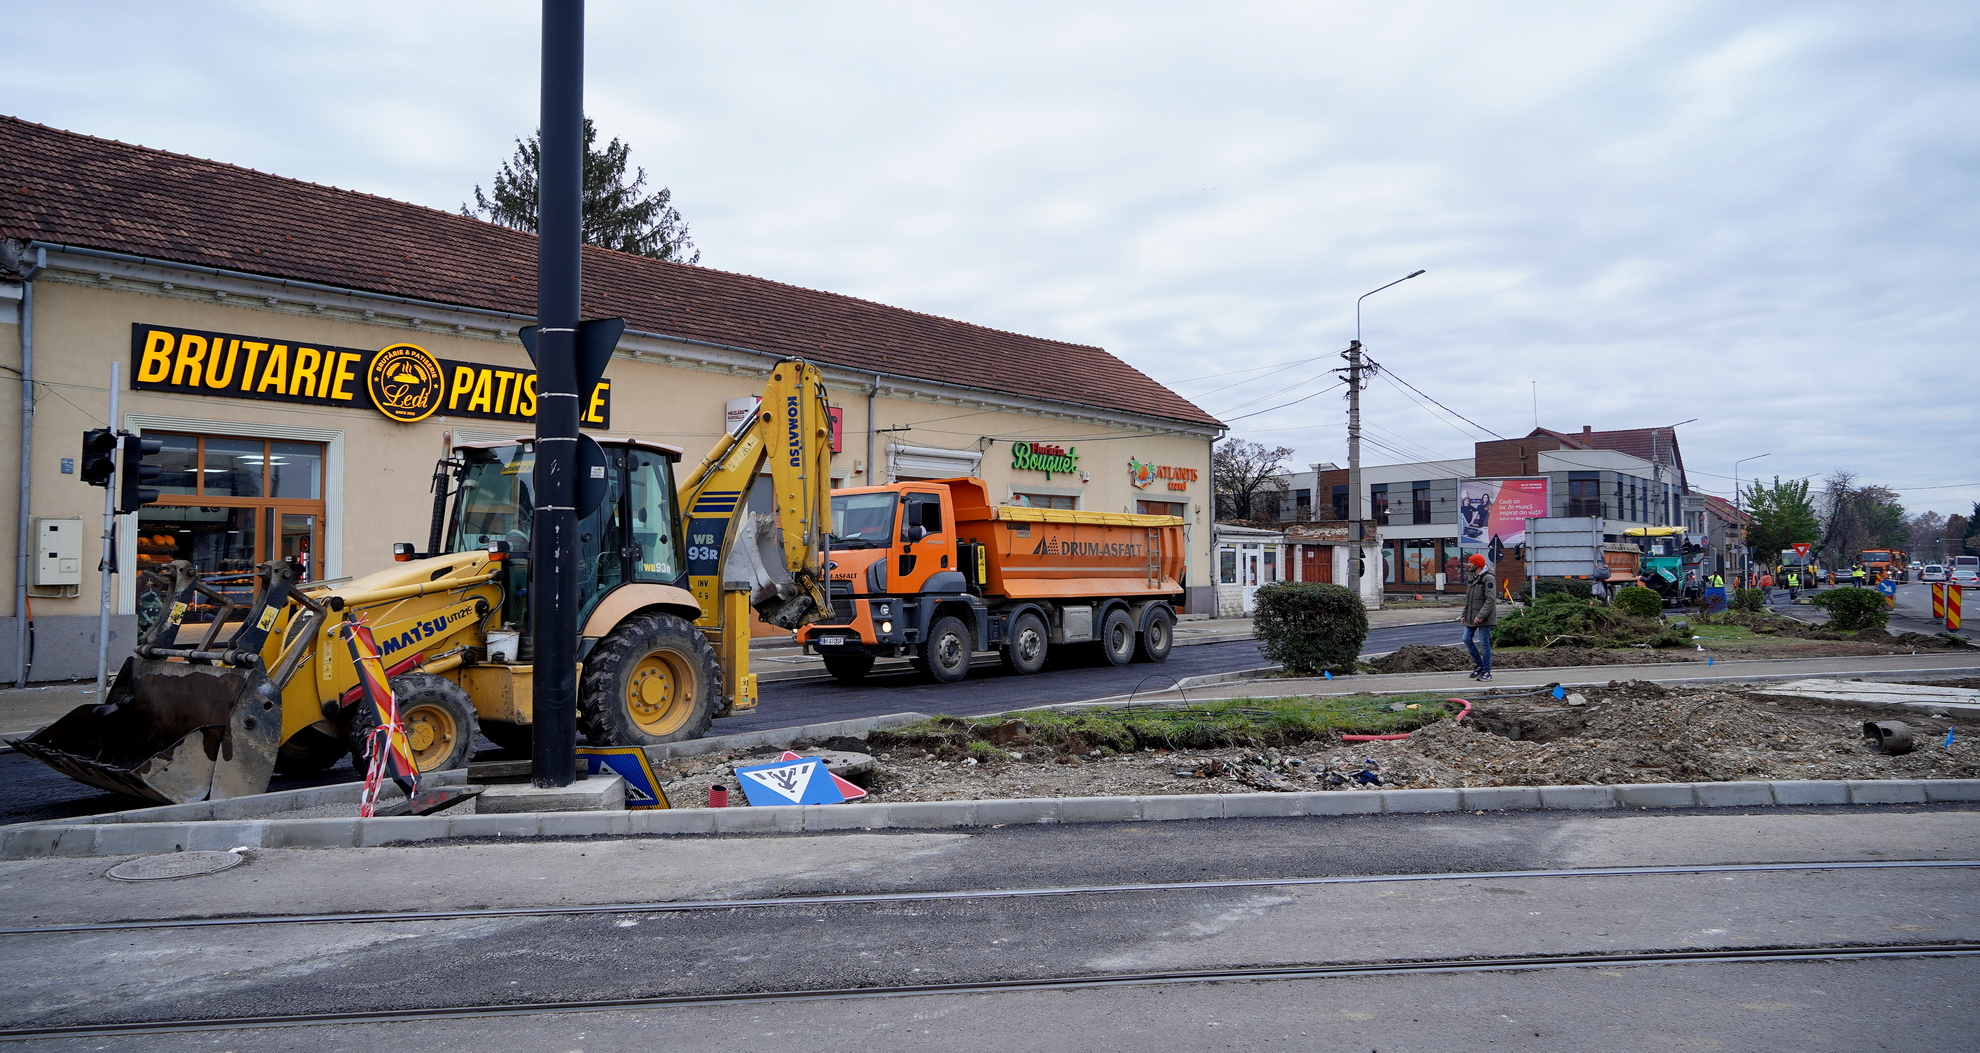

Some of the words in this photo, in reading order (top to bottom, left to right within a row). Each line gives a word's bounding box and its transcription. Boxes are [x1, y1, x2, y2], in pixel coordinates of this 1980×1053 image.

[137, 330, 362, 400] BRUTARIE
[382, 384, 428, 409] Ledi
[448, 366, 610, 423] PATISE
[788, 396, 801, 467] KOMATSU
[1012, 441, 1082, 480] Bouquet
[1156, 465, 1198, 481] ATLANTIS
[688, 547, 718, 560] 93R
[693, 534, 714, 544] WB
[1062, 541, 1142, 557] DRUM-ASFALT
[376, 615, 448, 656] MATSU
